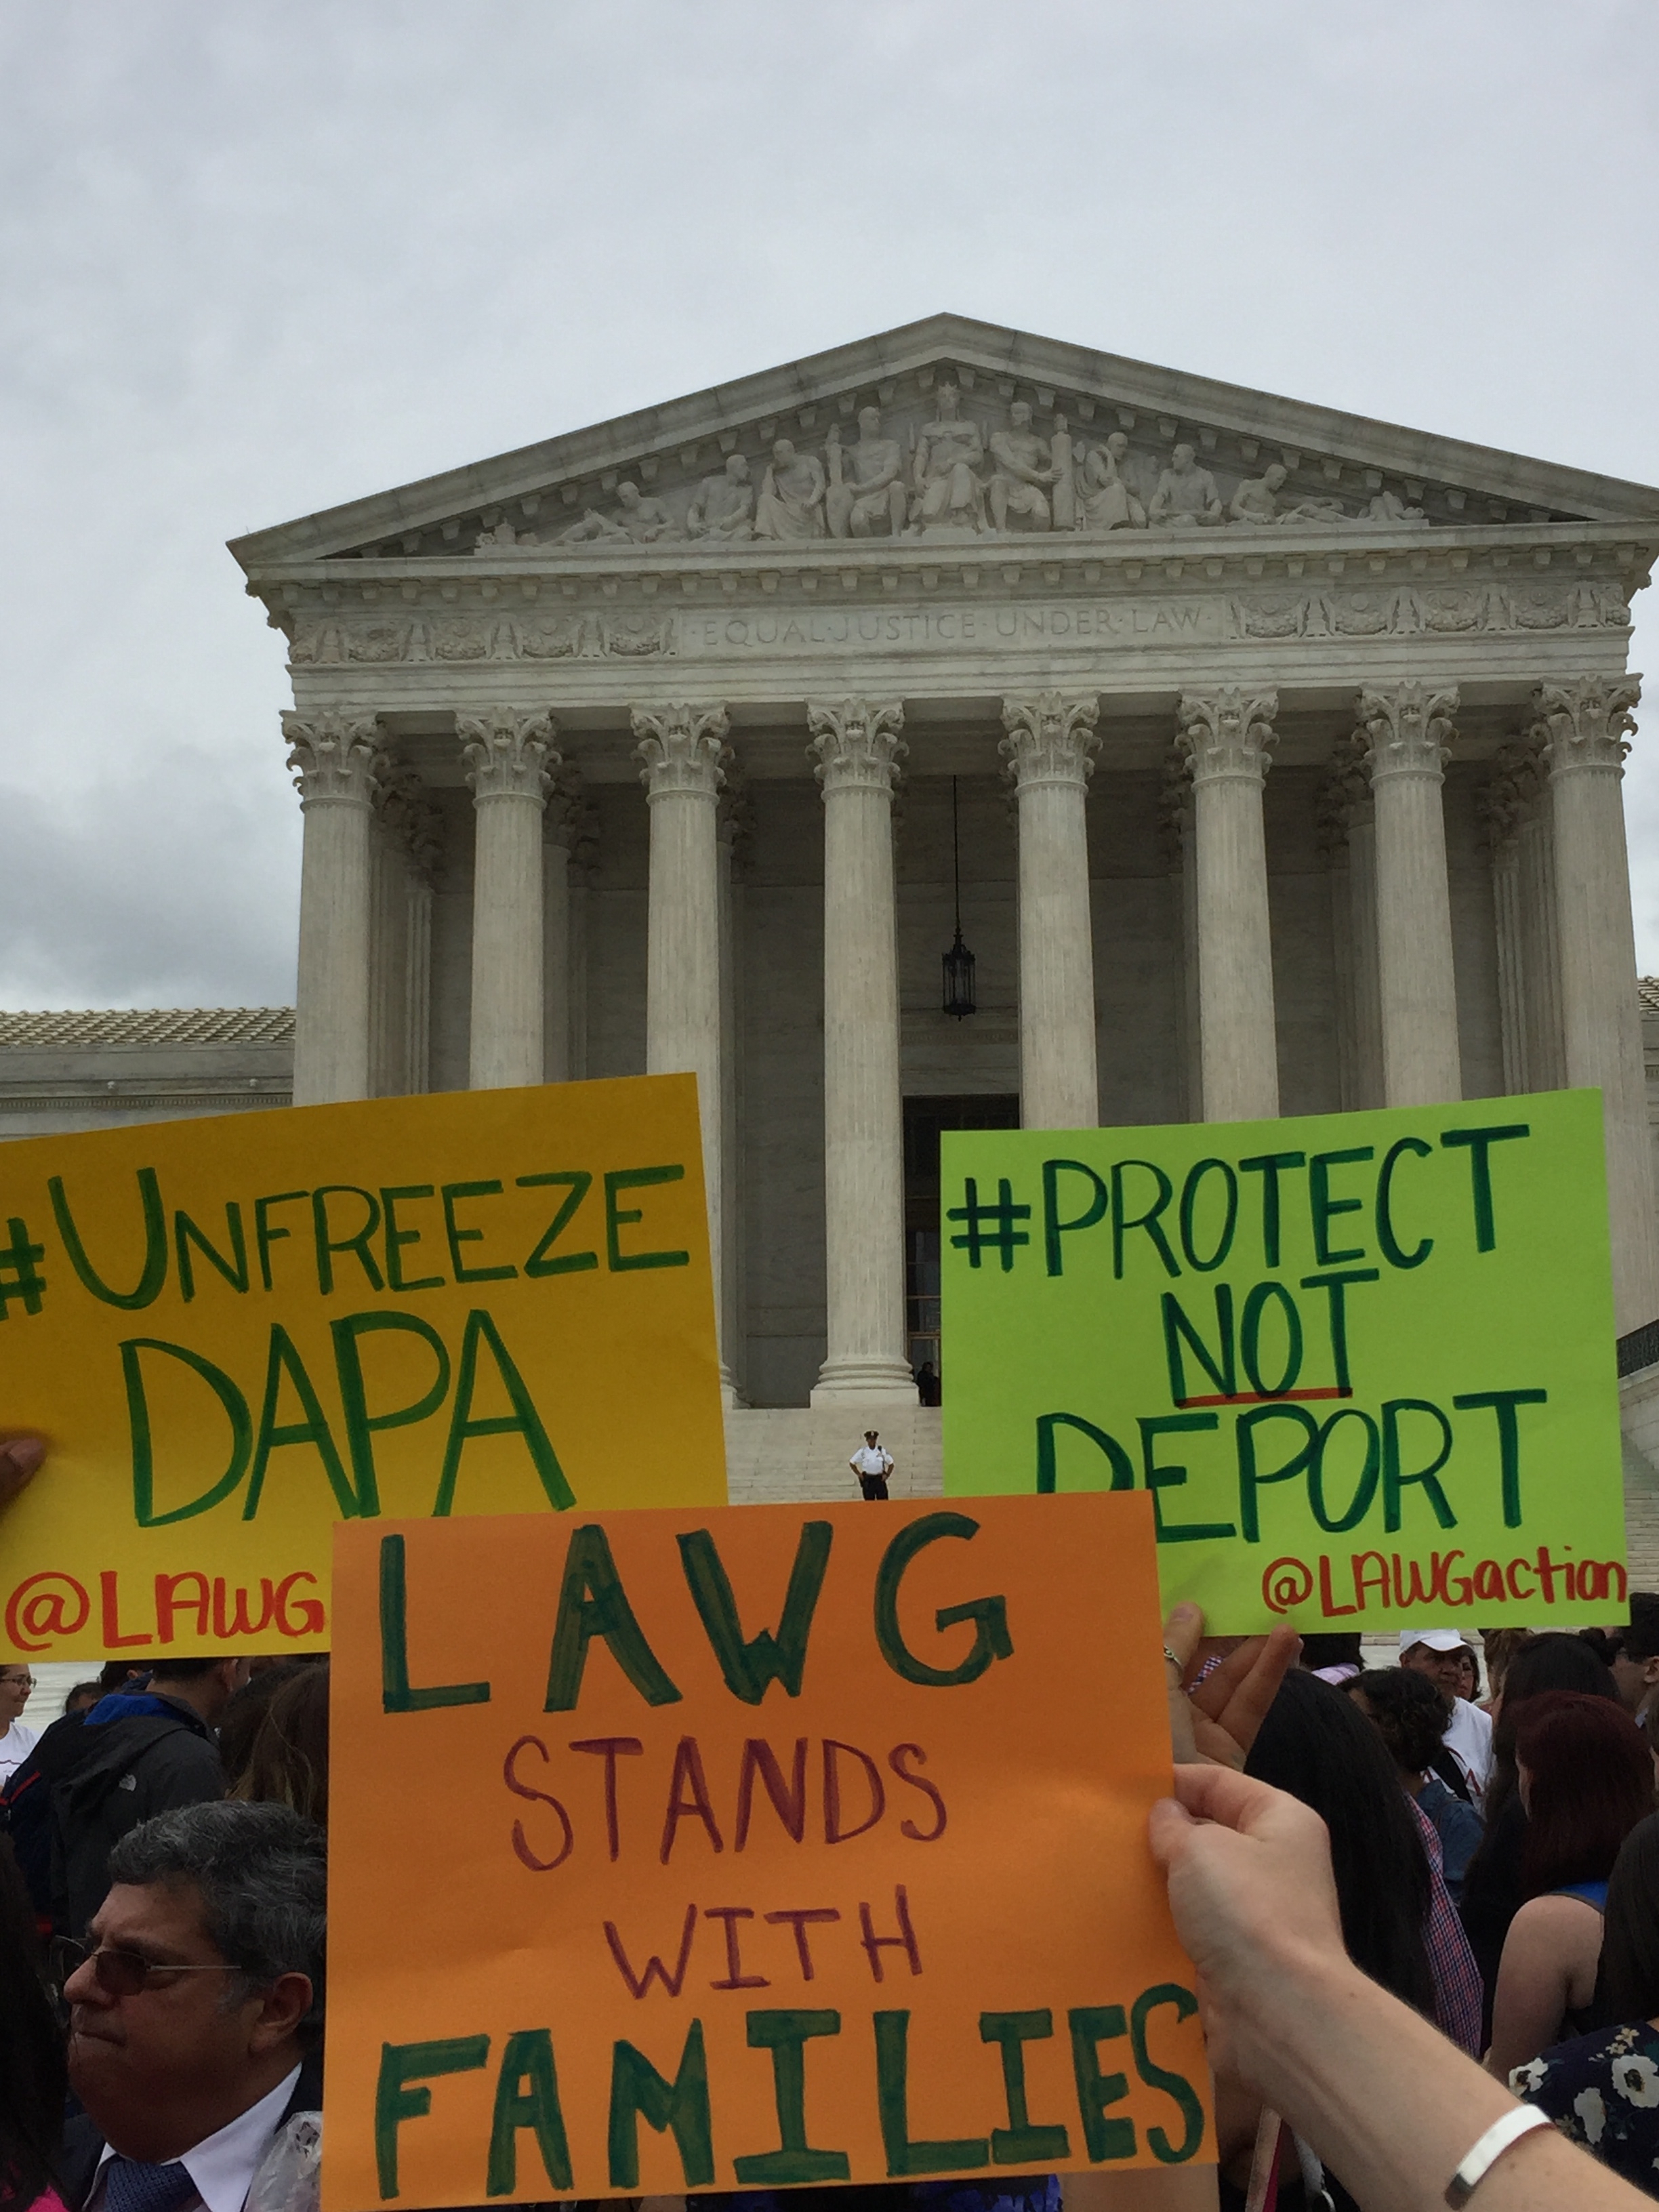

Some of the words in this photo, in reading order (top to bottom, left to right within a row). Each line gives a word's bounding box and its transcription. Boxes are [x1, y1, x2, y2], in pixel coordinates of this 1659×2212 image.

[702, 617, 825, 647] EQUAL
[833, 613, 976, 642] JUSTICE
[994, 608, 1120, 637] UNDER
[1130, 607, 1201, 634] LAW
[0, 1164, 690, 1321] #UNFREEZE
[946, 1124, 1530, 1280] #PROTECT
[1160, 1267, 1380, 1408] NOT
[118, 1308, 577, 1528] DAPA
[1036, 1388, 1547, 1543] DEPORT
[4, 1570, 325, 1652] @LAWG
[380, 1511, 1015, 1714] LAWG
[1261, 1544, 1627, 1618] @LAWGaction
[503, 1734, 947, 1871] STANDS
[602, 1883, 923, 2000] WITH
[374, 1982, 1206, 2201] FAMILIES
